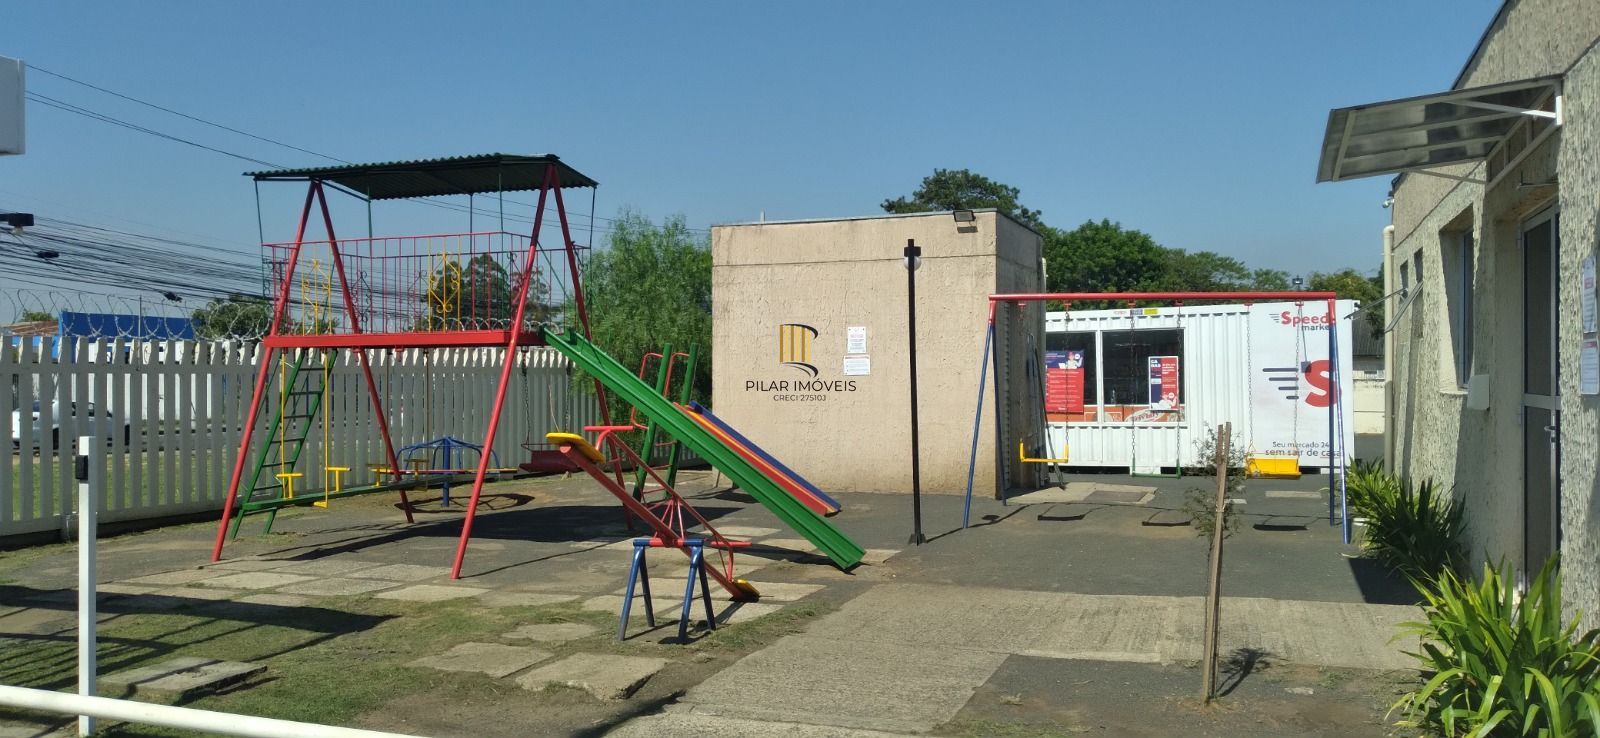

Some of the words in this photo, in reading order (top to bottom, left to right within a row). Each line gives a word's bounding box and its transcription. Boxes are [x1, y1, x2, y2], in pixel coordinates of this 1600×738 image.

[1302, 323, 1330, 331] marke
[1304, 359, 1342, 408] S
[1306, 448, 1319, 457] de
